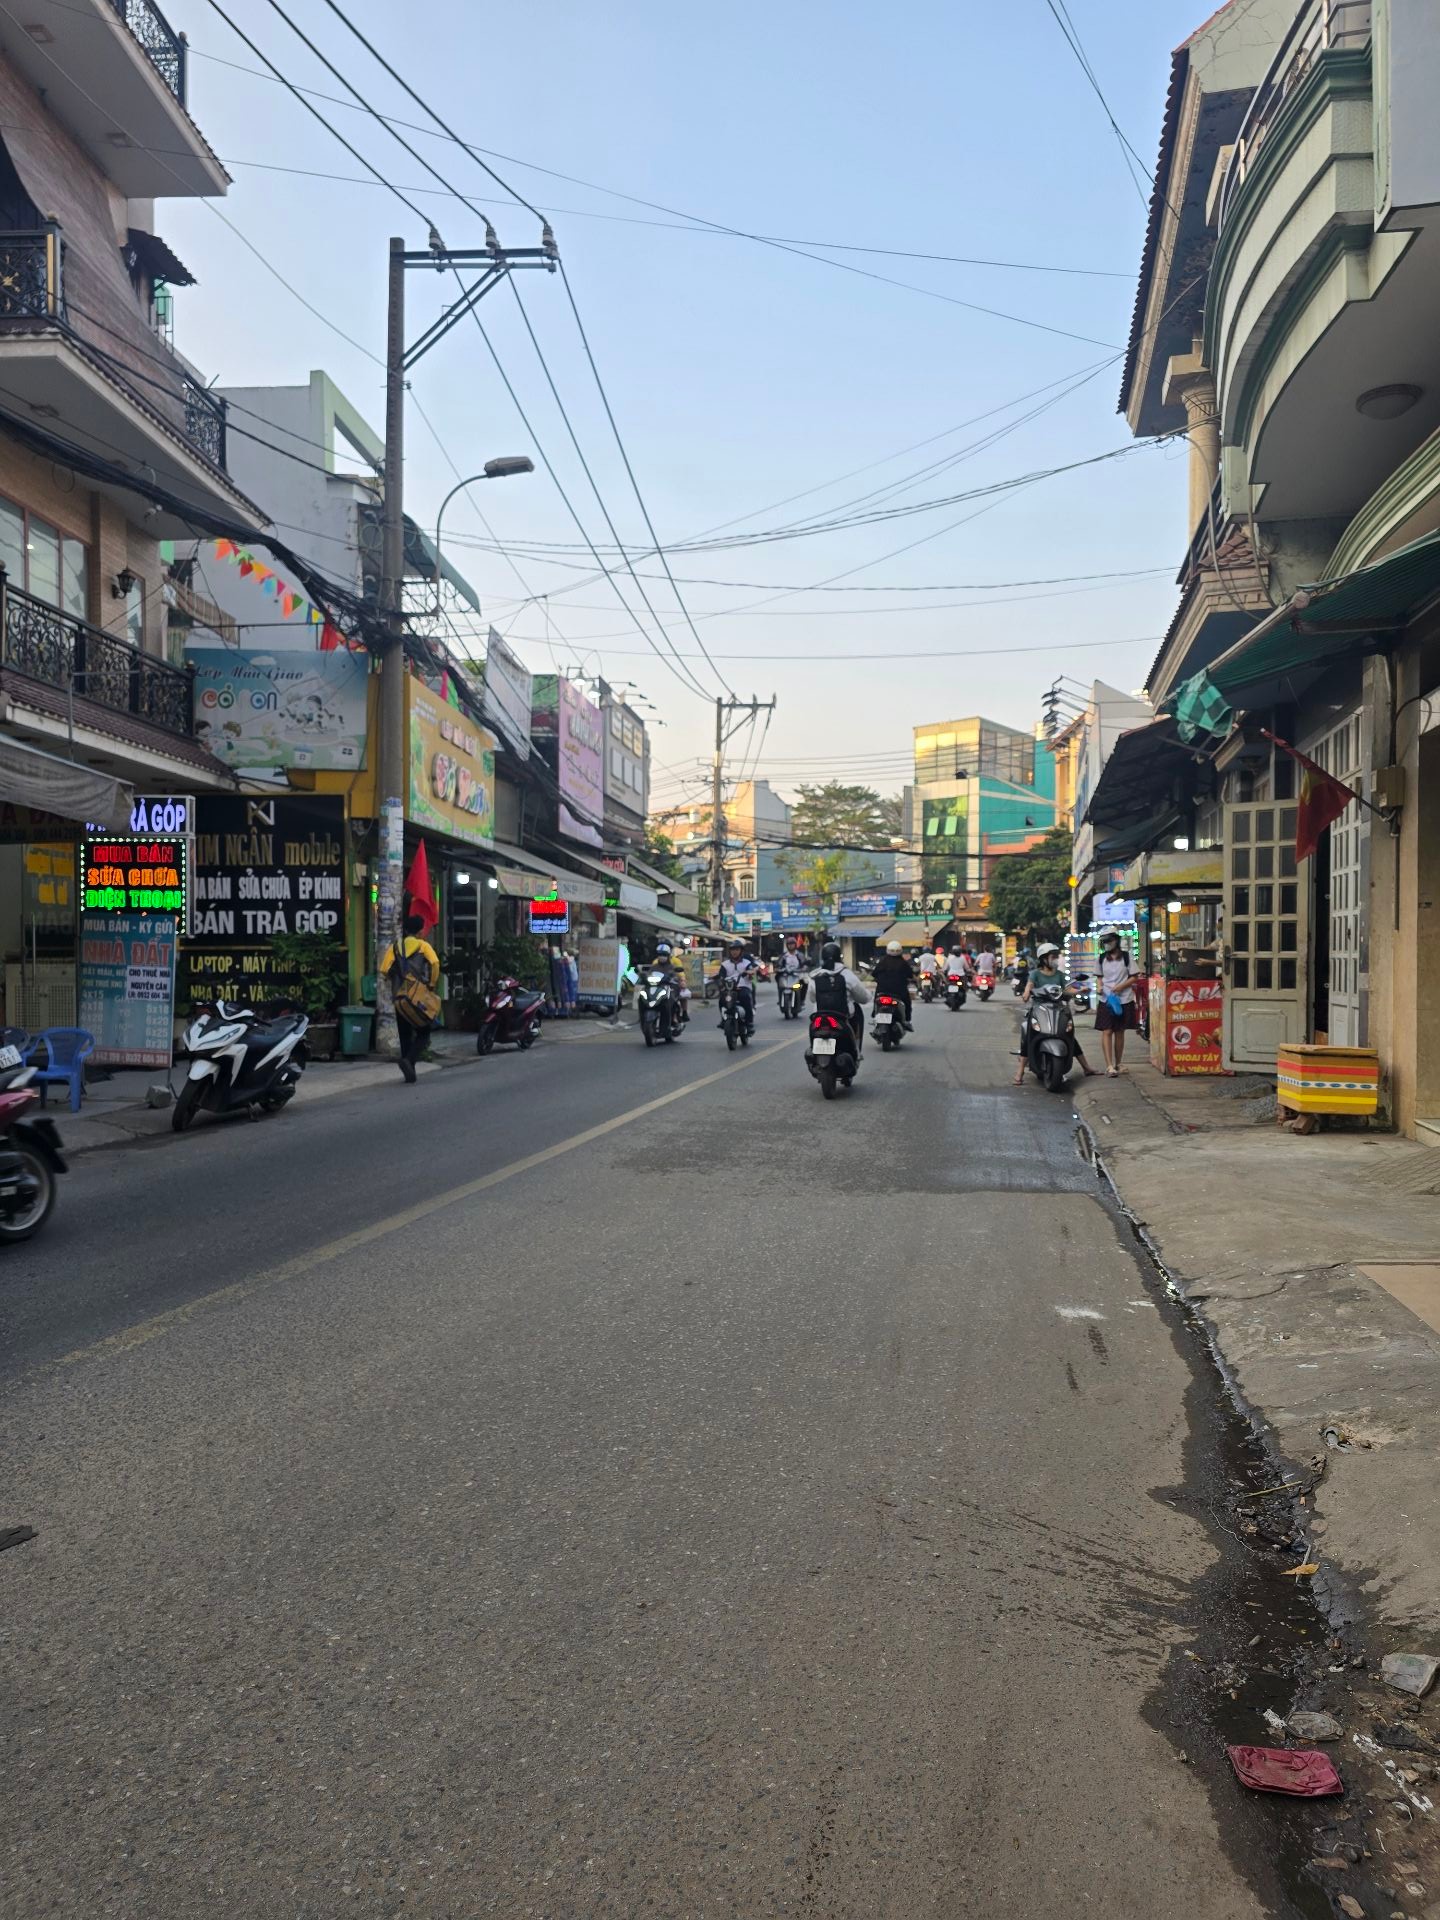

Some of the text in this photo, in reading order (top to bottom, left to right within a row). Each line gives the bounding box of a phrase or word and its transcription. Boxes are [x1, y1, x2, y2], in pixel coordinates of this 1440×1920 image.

[151, 797, 186, 833] GÓP
[94, 844, 174, 863] MUA BÁN
[197, 826, 341, 866] IM NGÂN mobile
[207, 871, 231, 899] BÁN
[238, 868, 261, 899] SỬA
[261, 869, 291, 899] CHỮA
[299, 871, 313, 899] ÉP
[314, 871, 341, 900] KÍNH
[86, 887, 182, 911] ĐIỆN THOẠI
[84, 919, 106, 931] MUA
[108, 918, 130, 933] BÁN
[139, 919, 153, 934] KÝ
[155, 919, 173, 934] GỬI
[194, 901, 338, 934] BÁN TRẢ GÓP
[82, 935, 172, 967] NHÀ ĐẤT
[243, 952, 268, 973] MÁY
[1169, 985, 1195, 1004] GÀ
